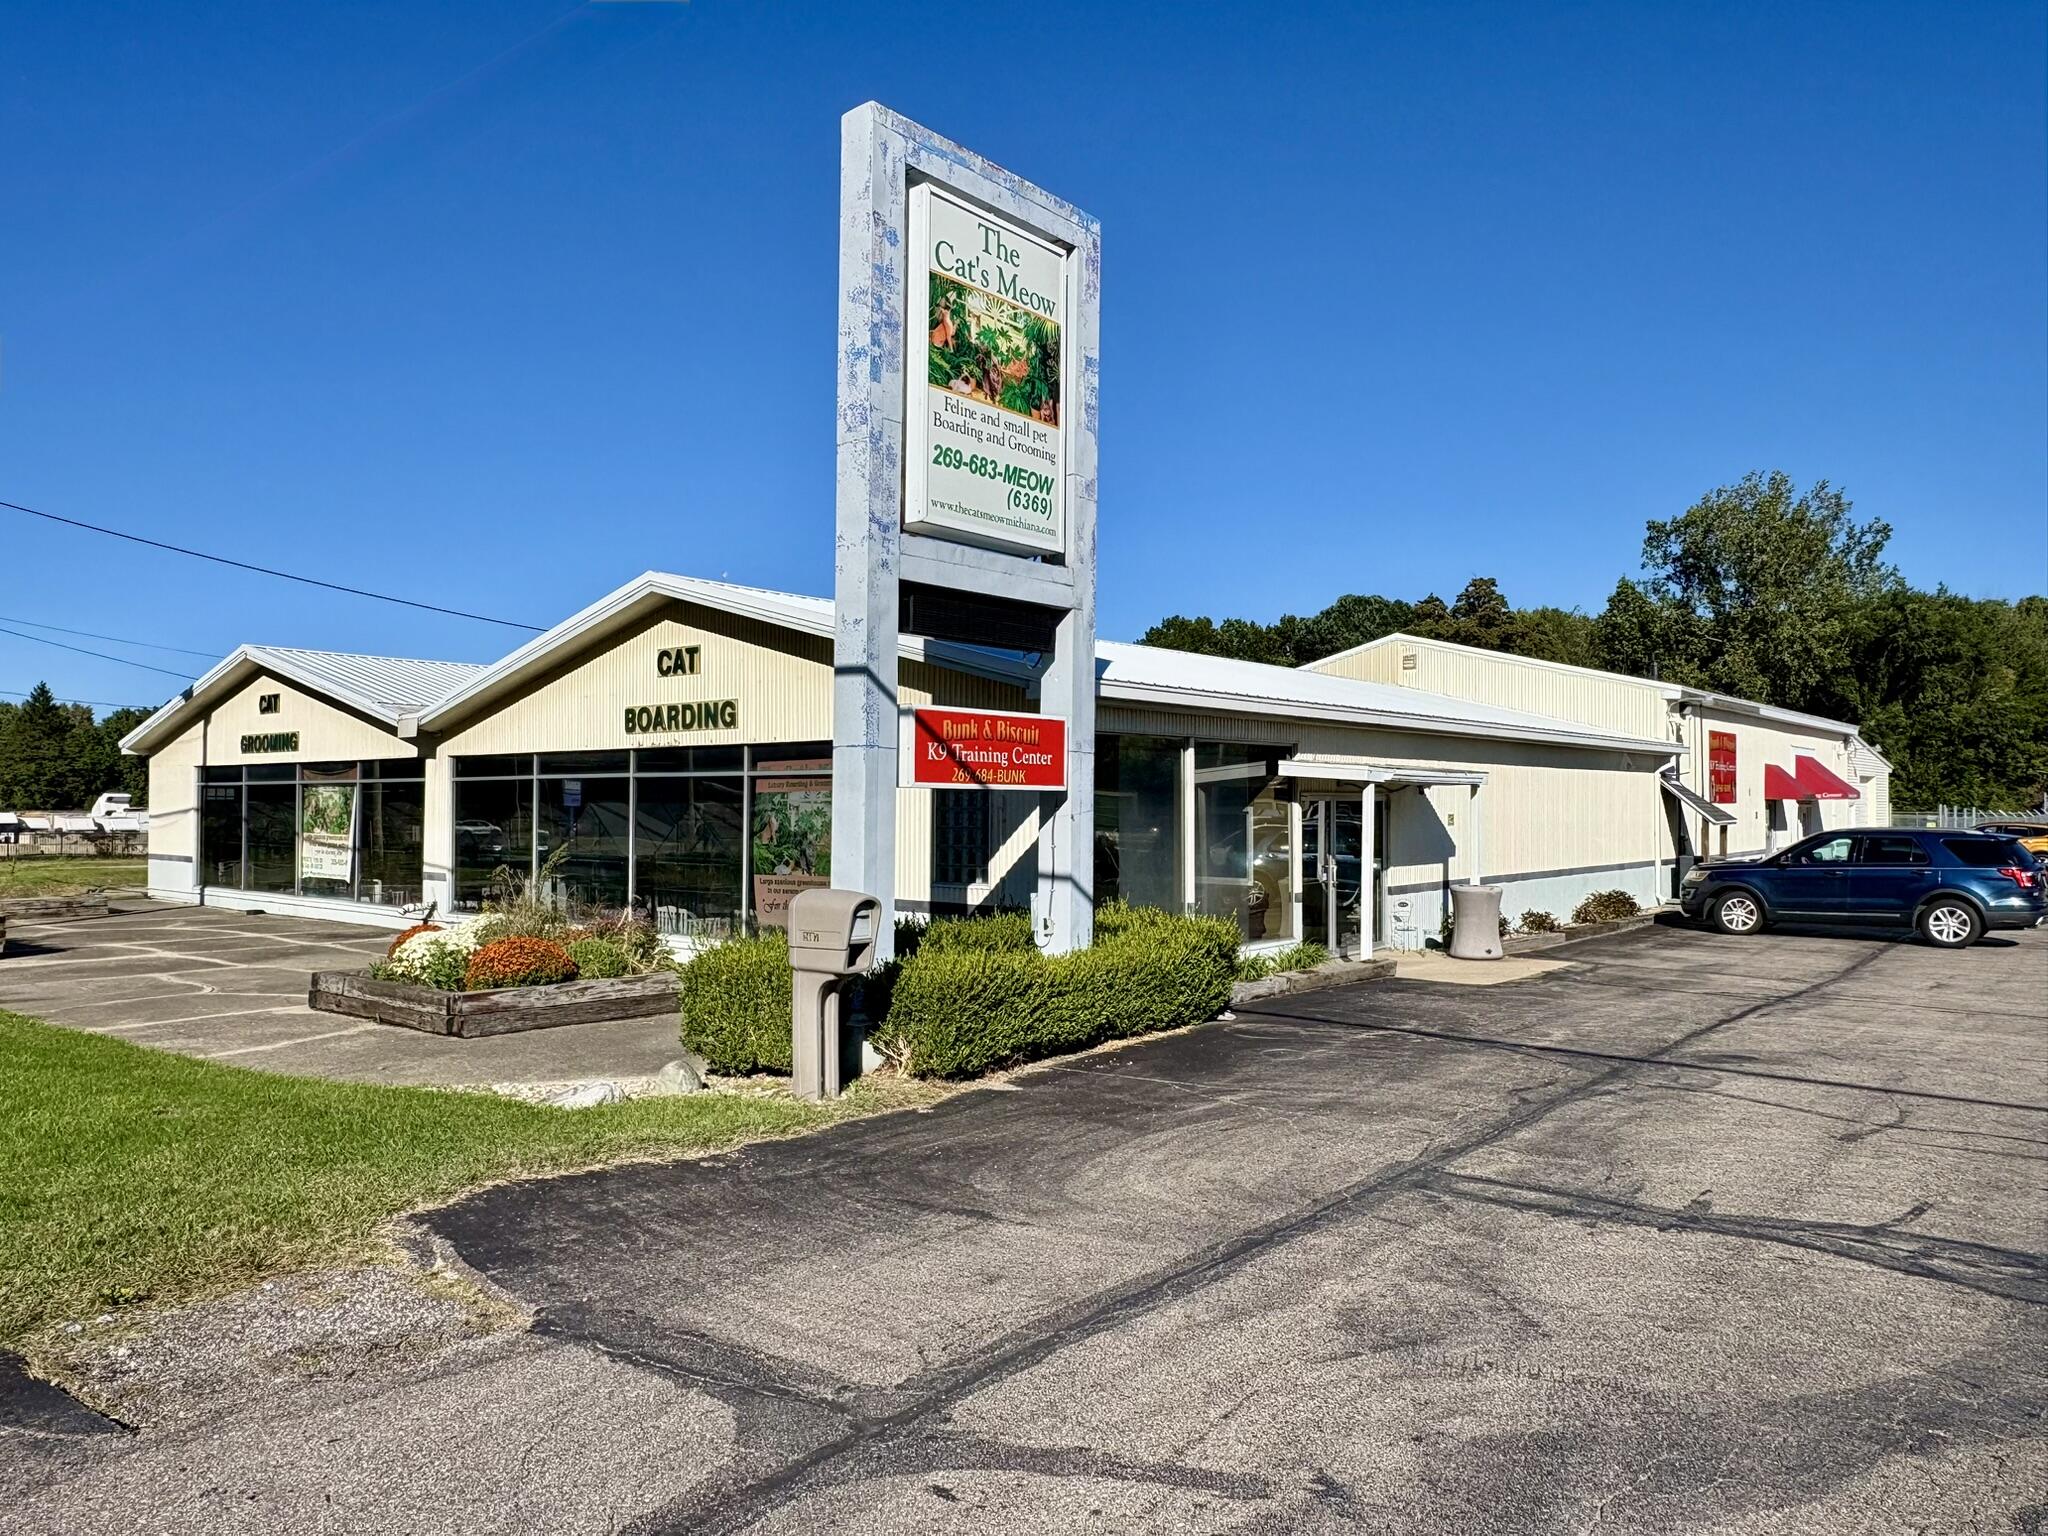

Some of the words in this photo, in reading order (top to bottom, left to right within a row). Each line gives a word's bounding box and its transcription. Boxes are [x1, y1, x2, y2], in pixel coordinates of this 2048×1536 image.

[978, 222, 1020, 267] The
[935, 240, 989, 288] Cat's
[996, 265, 1056, 317] Meow
[944, 395, 977, 420] Feline
[980, 412, 1000, 428] and
[1004, 420, 1030, 438] small
[1033, 430, 1048, 444] pet
[933, 411, 983, 443] Boarding
[986, 431, 1005, 447] and
[1008, 435, 1056, 465] Grooming
[932, 444, 1055, 496] 269-683-MEOW
[931, 499, 1057, 537] www.thecatsmeowmichiana.com
[1007, 488, 1053, 520] (6369)
[657, 645, 699, 677] CAT
[259, 694, 280, 715] CAT
[625, 700, 737, 734] BOARDING
[240, 731, 299, 754] GROOMING
[943, 718, 978, 742] Bunk
[983, 719, 993, 740] &
[996, 720, 1040, 746] Biscuit
[927, 742, 947, 761] K9
[952, 743, 1008, 767] Training
[1012, 747, 1053, 766] Center
[951, 767, 1026, 784] 269-684-BUNK
